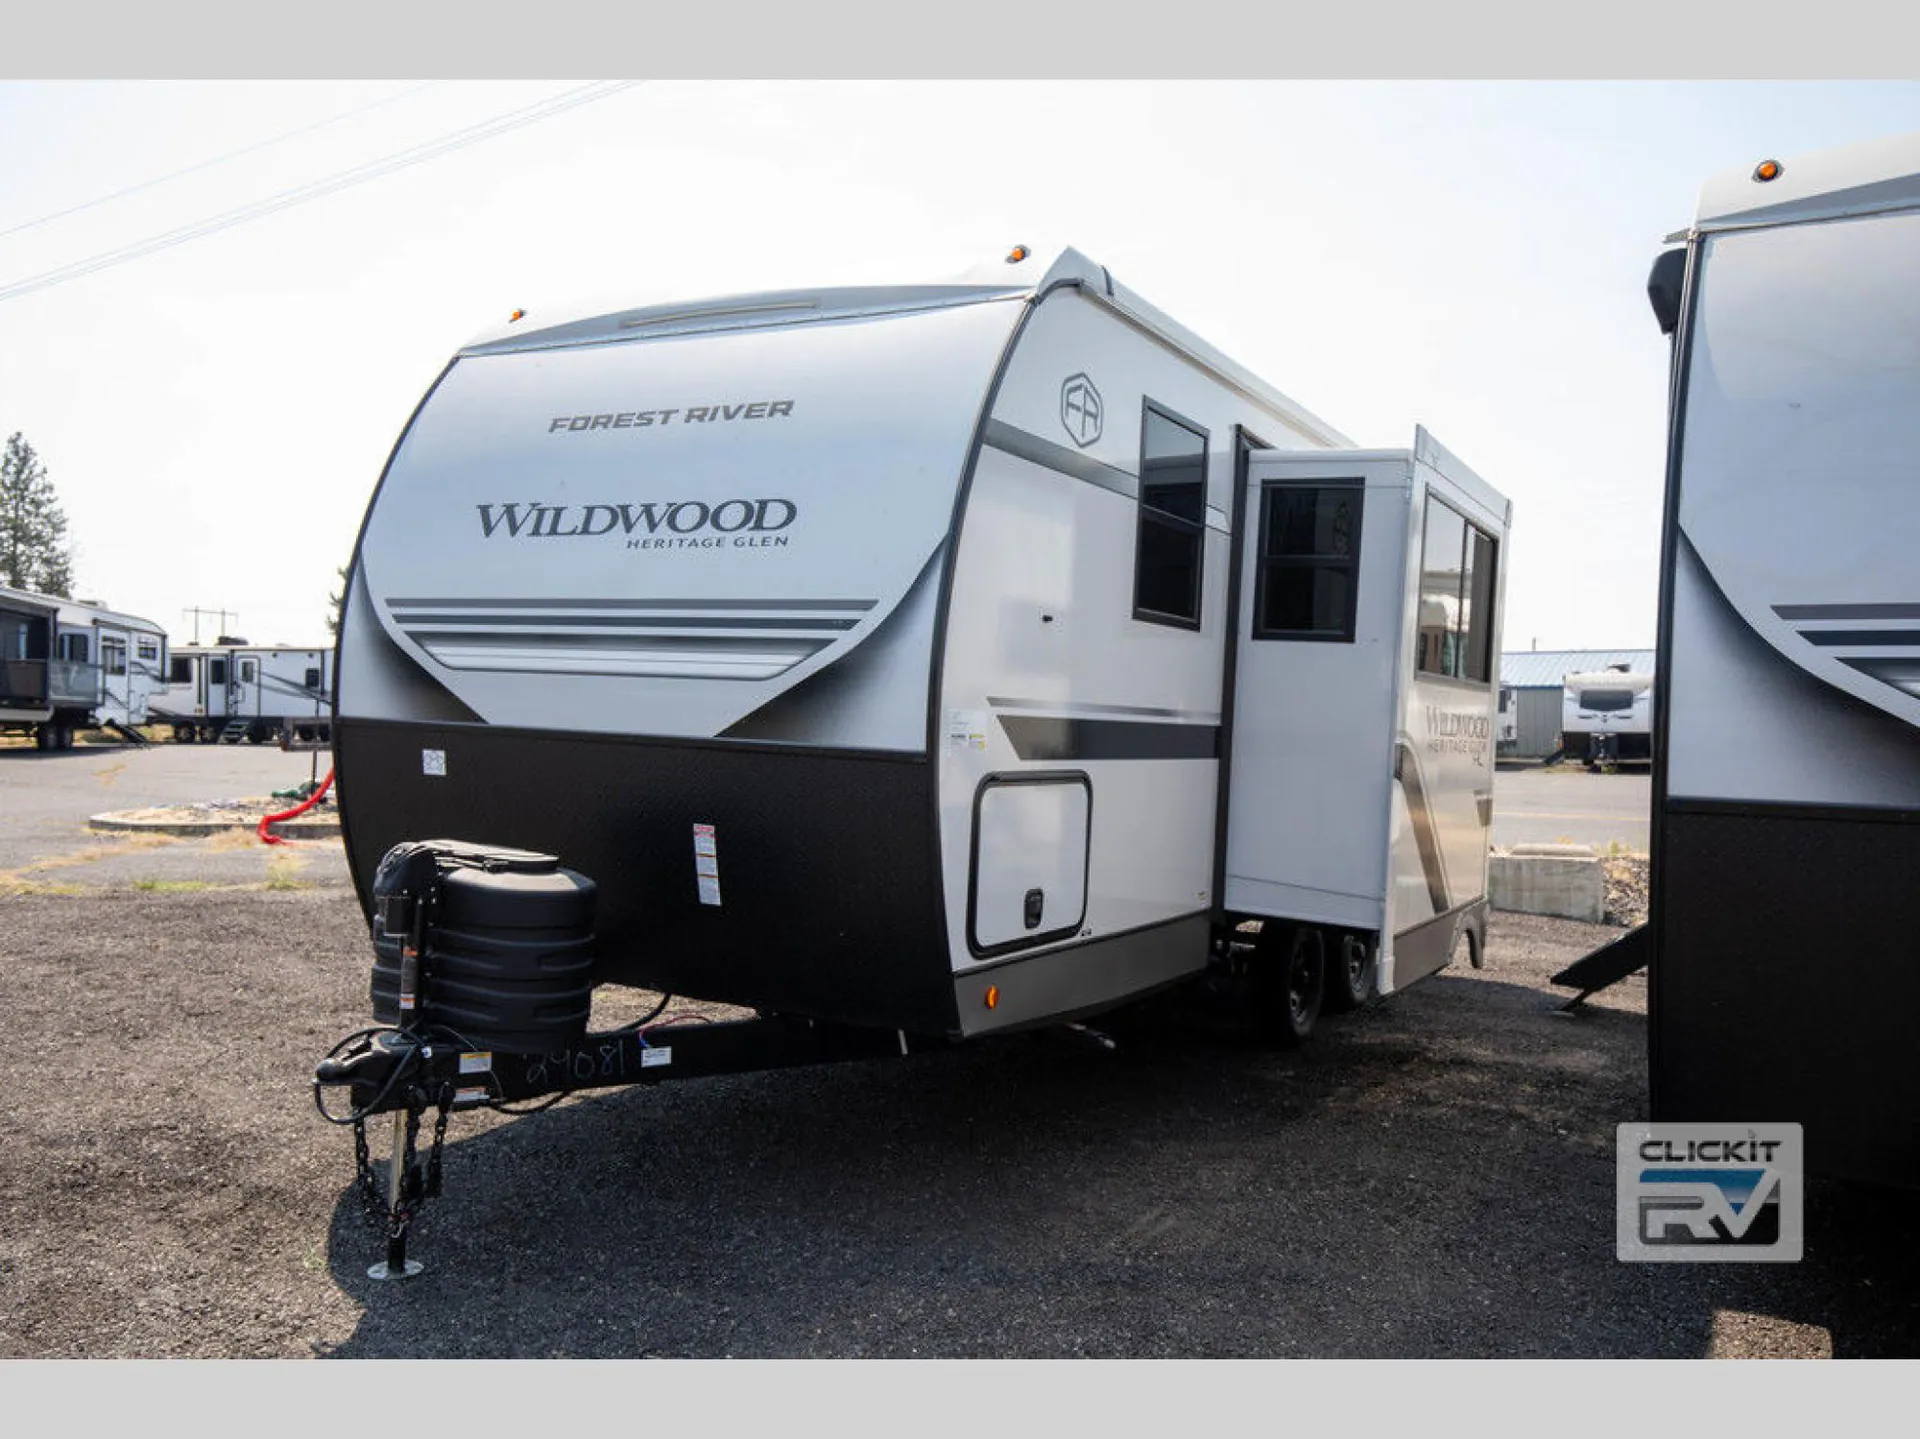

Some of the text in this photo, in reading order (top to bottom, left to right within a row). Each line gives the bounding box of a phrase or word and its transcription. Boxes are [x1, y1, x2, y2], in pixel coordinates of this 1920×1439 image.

[548, 400, 795, 432] FOREST RIVER
[476, 498, 797, 537] WILDWOOD
[626, 535, 789, 549] HERITAGE GLEN
